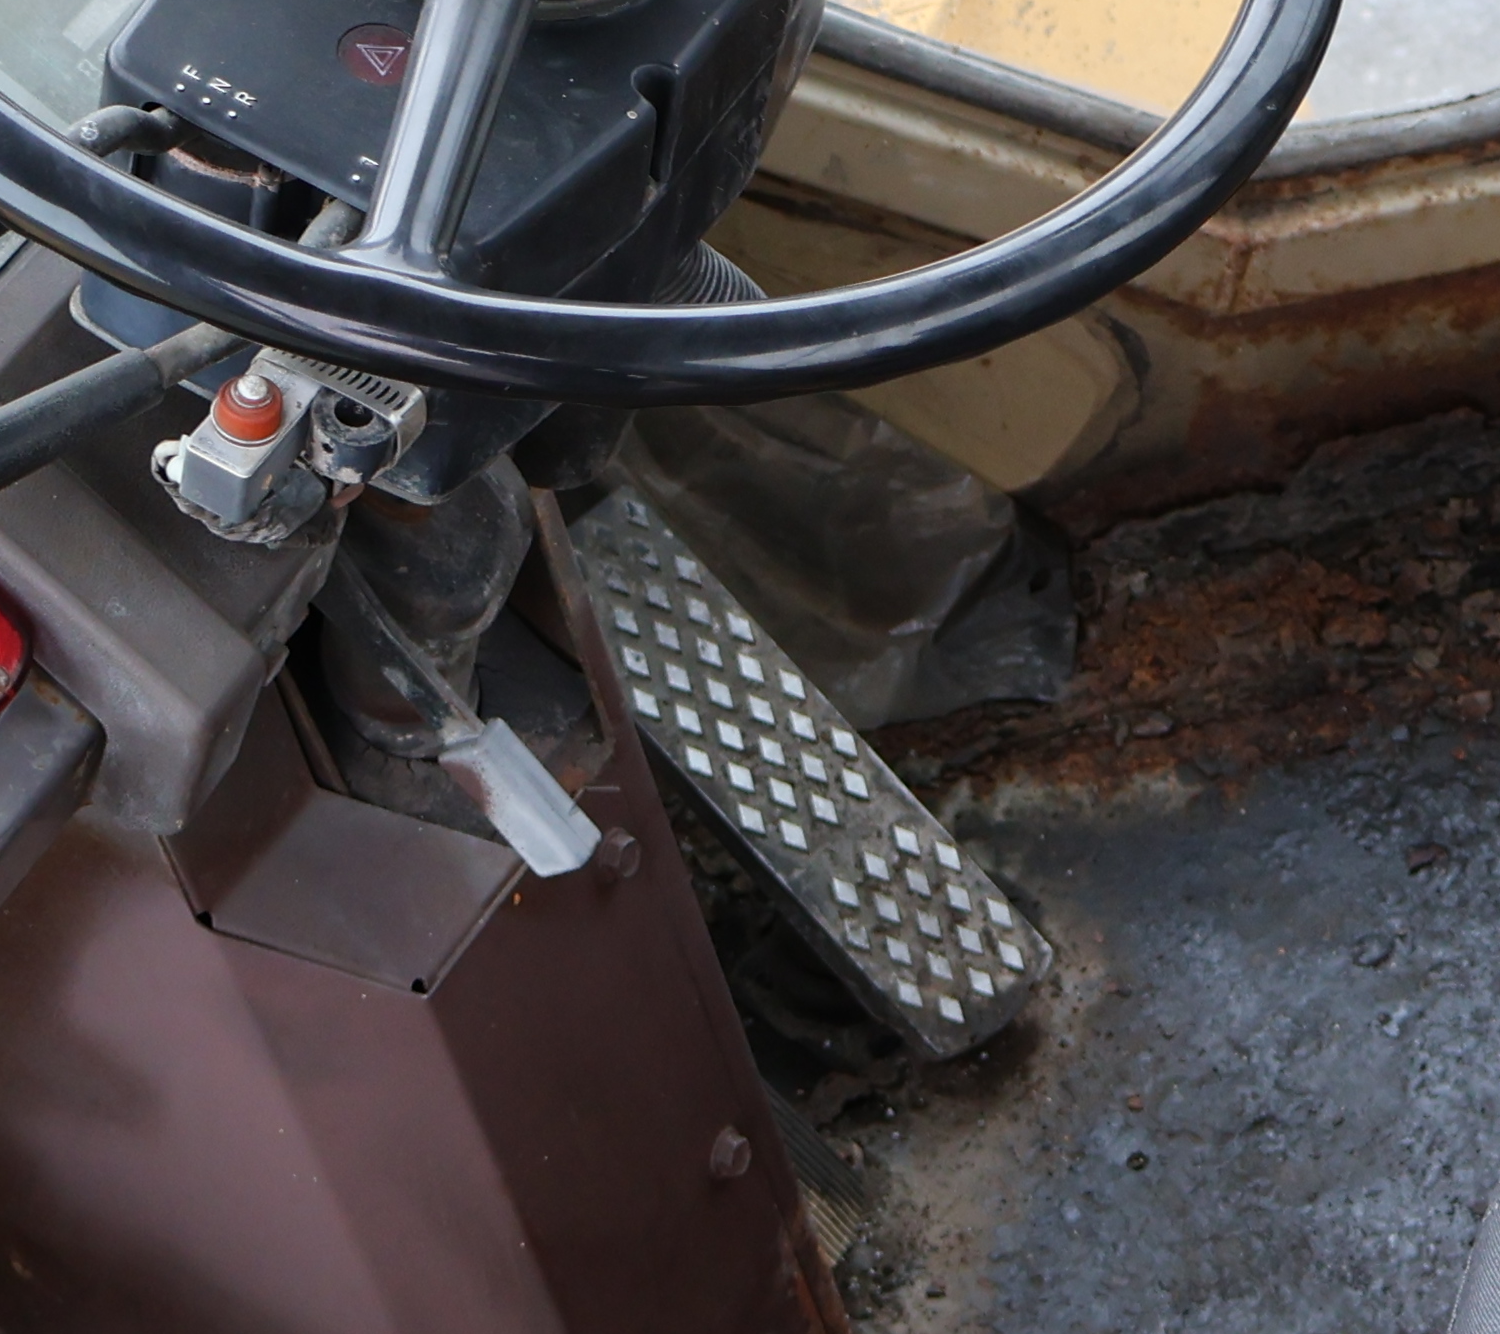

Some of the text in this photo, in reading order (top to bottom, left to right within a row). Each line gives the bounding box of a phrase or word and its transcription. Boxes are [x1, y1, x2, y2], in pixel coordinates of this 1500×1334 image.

[182, 64, 202, 81] F
[208, 78, 233, 94] N
[233, 91, 258, 107] R
